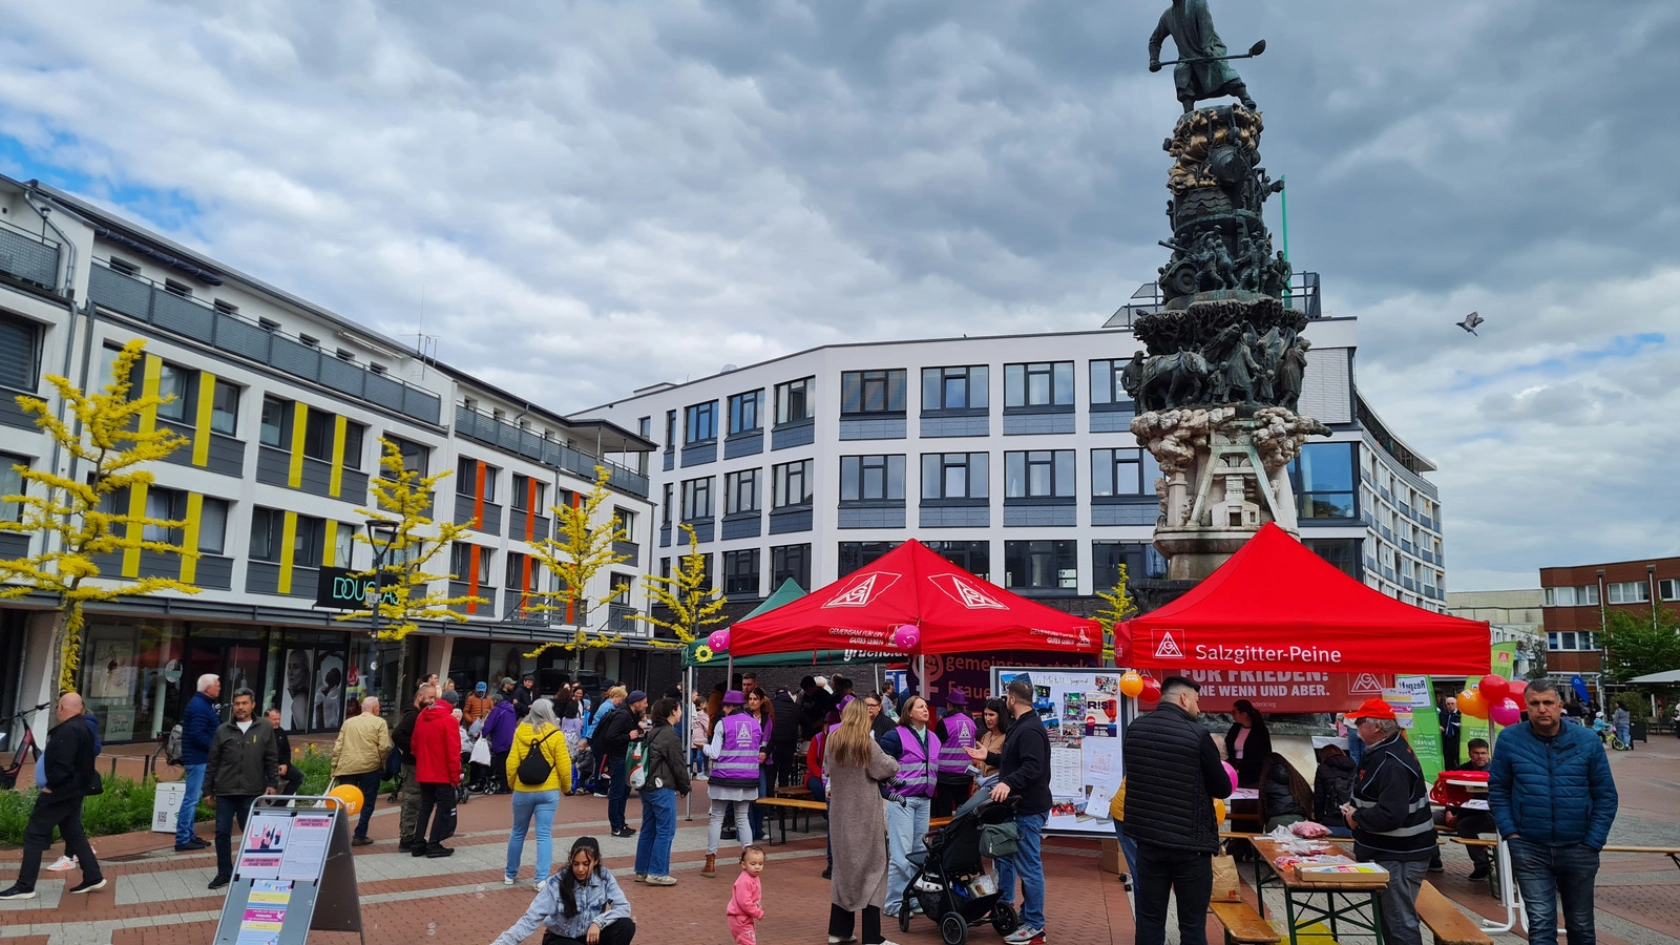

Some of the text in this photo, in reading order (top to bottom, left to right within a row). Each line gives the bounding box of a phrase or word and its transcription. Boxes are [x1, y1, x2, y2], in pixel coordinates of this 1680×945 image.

[333, 576, 400, 605] DOUAS
[1196, 644, 1342, 665] Salzgitter-Peine
[1218, 685, 1257, 697] WENN
[1260, 685, 1288, 697] UND
[1291, 684, 1331, 697] ABER.
